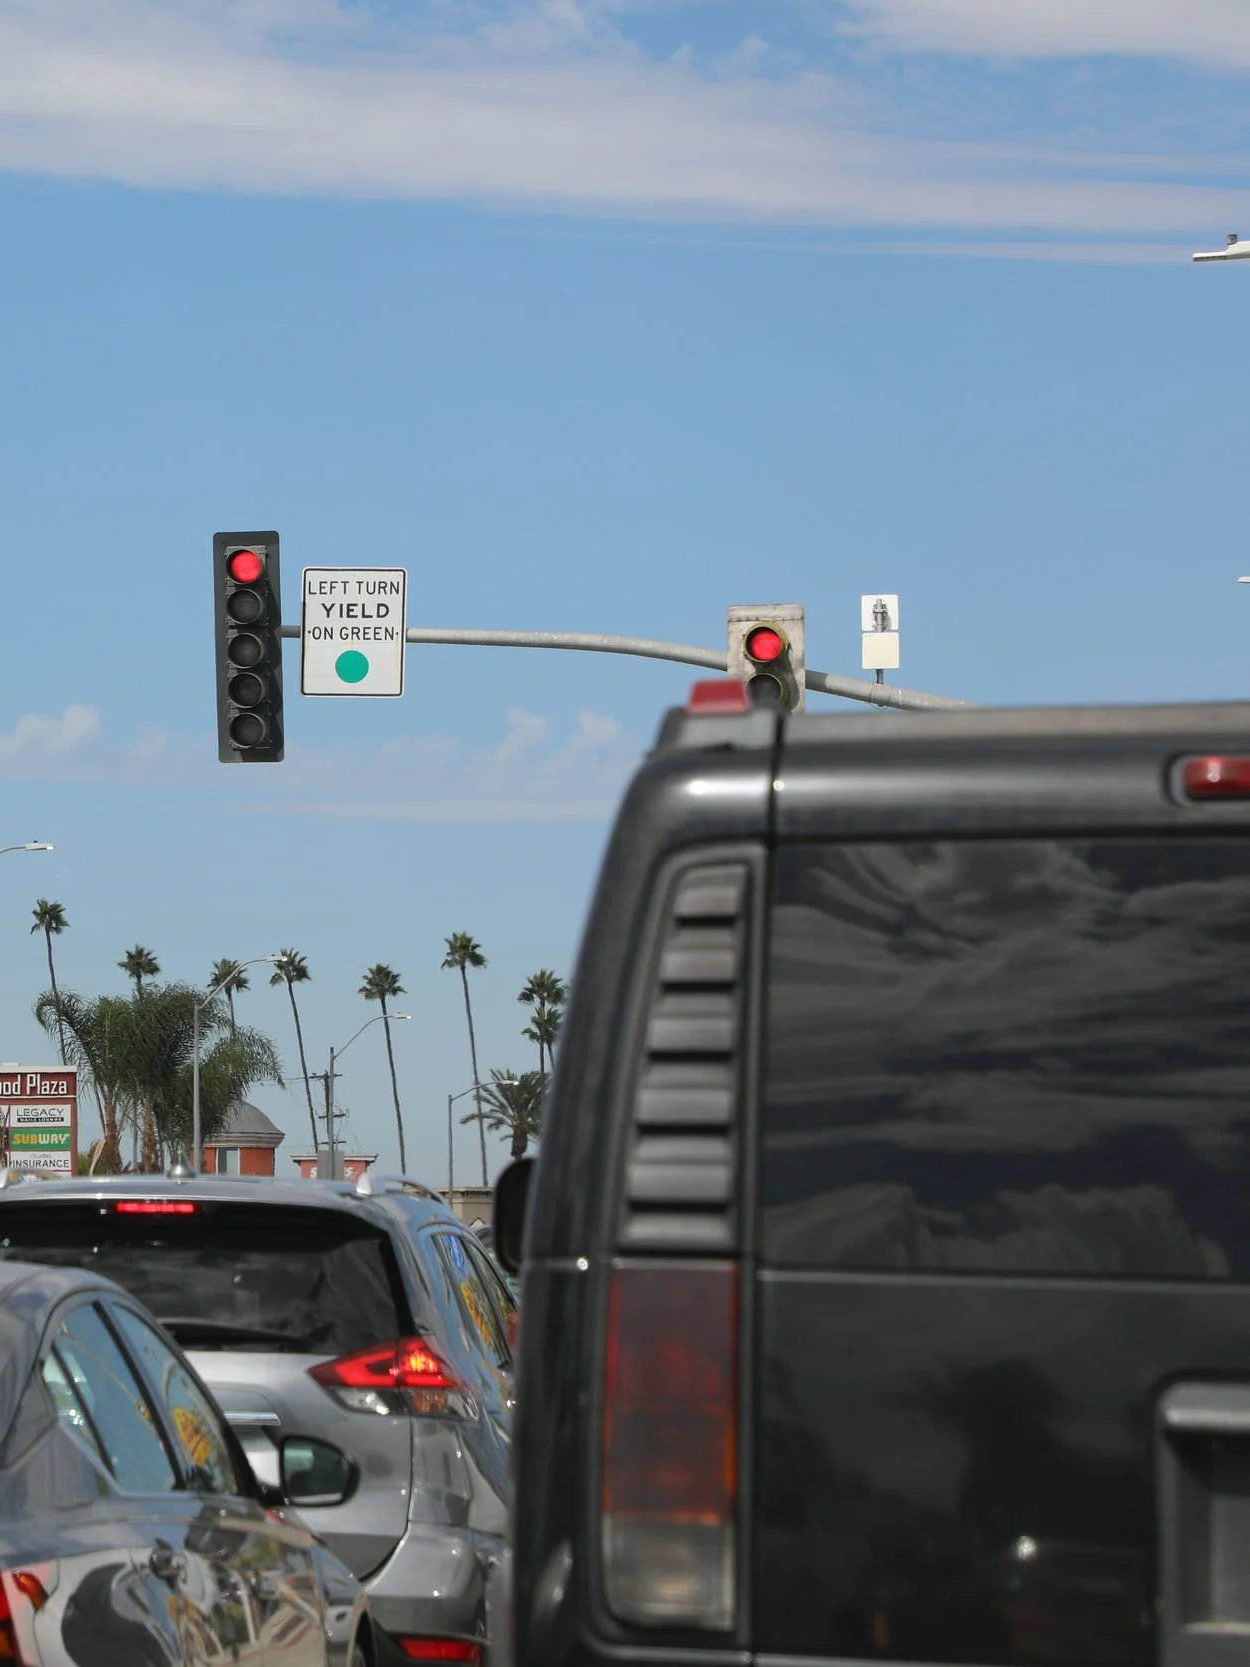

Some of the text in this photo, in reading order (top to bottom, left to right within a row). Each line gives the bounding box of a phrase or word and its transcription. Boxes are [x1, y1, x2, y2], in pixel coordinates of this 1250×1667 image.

[308, 581, 400, 595] LEFT TURN
[321, 603, 390, 618] YIELD
[312, 626, 394, 641] ON GREEN
[27, 1074, 68, 1095] Plaza
[16, 1108, 65, 1117] LEGACY
[12, 1133, 70, 1145] SUBWAY
[13, 1159, 69, 1168] INSURANCE
